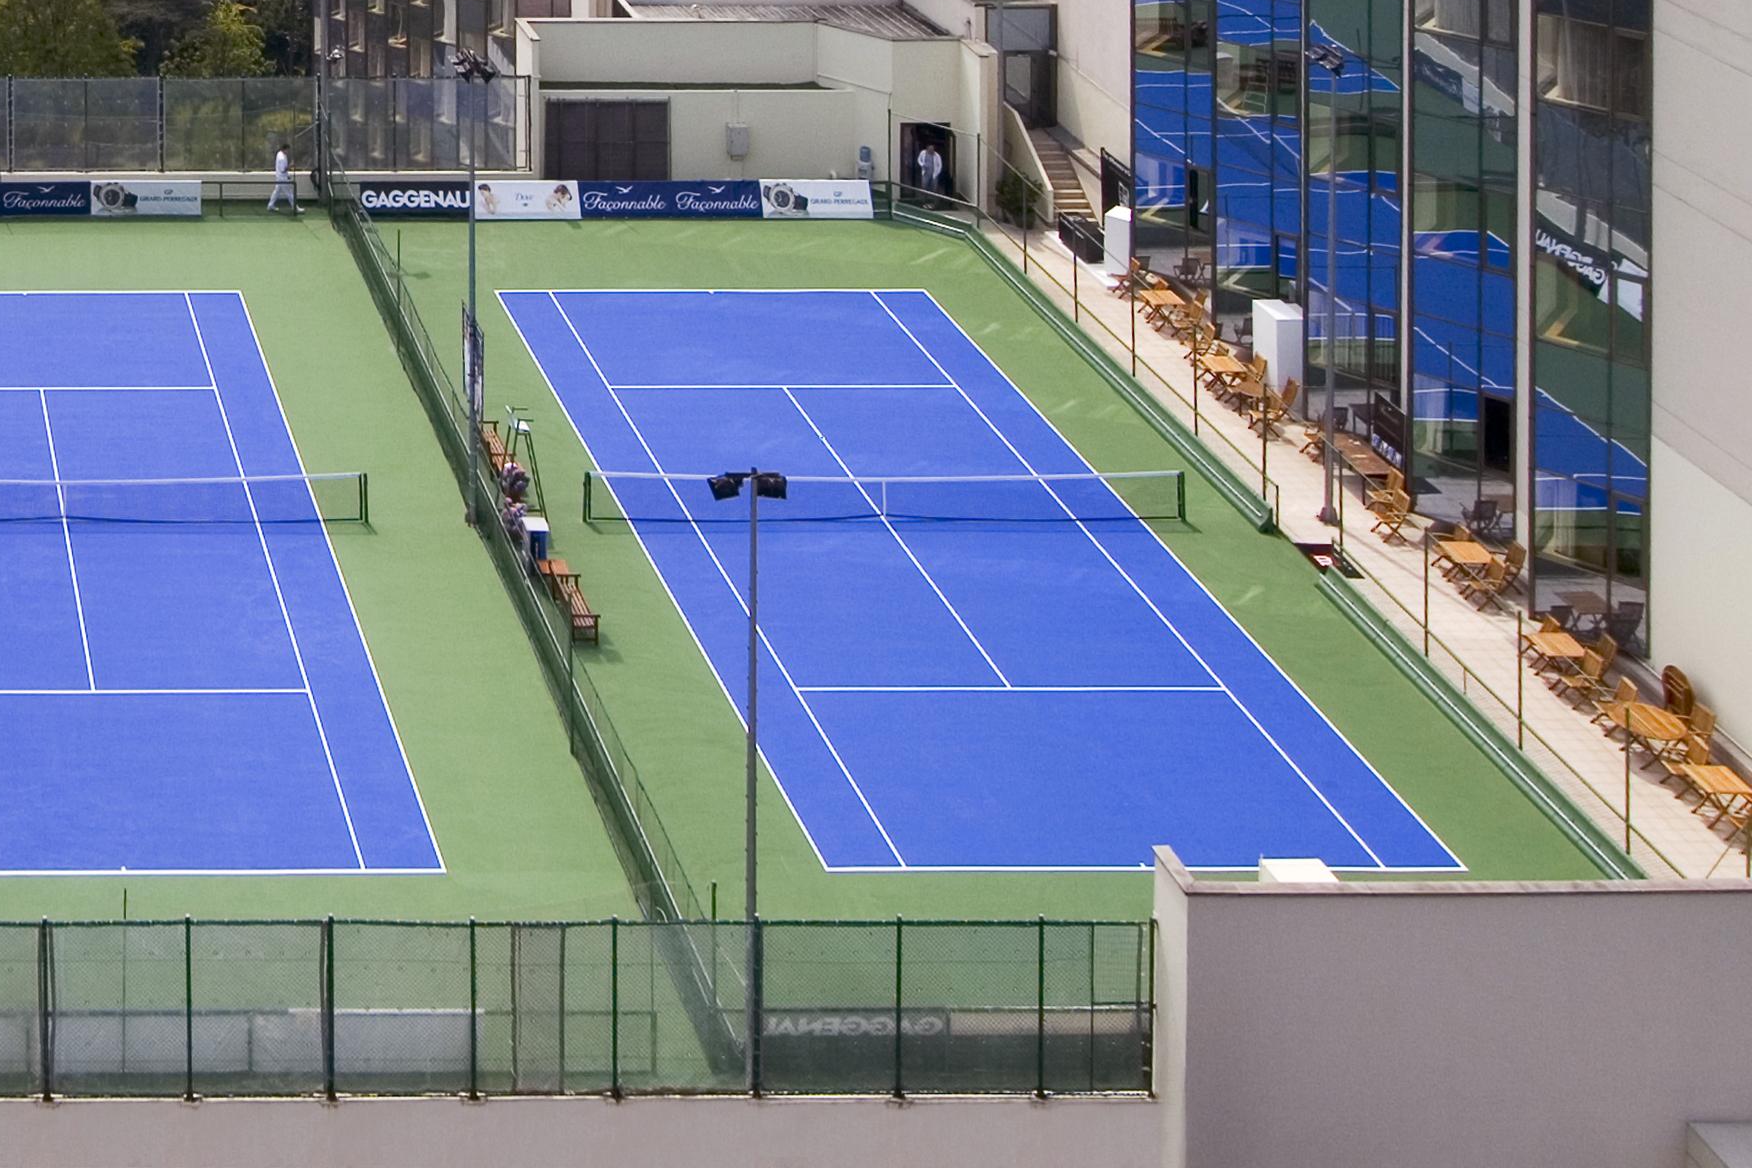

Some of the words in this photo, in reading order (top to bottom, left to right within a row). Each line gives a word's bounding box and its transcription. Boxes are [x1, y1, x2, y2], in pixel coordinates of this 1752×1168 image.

[3, 191, 85, 210] Façonnable
[361, 190, 470, 208] GAGGENAU
[583, 191, 666, 211] Façonnable
[676, 191, 759, 212] Façonnable
